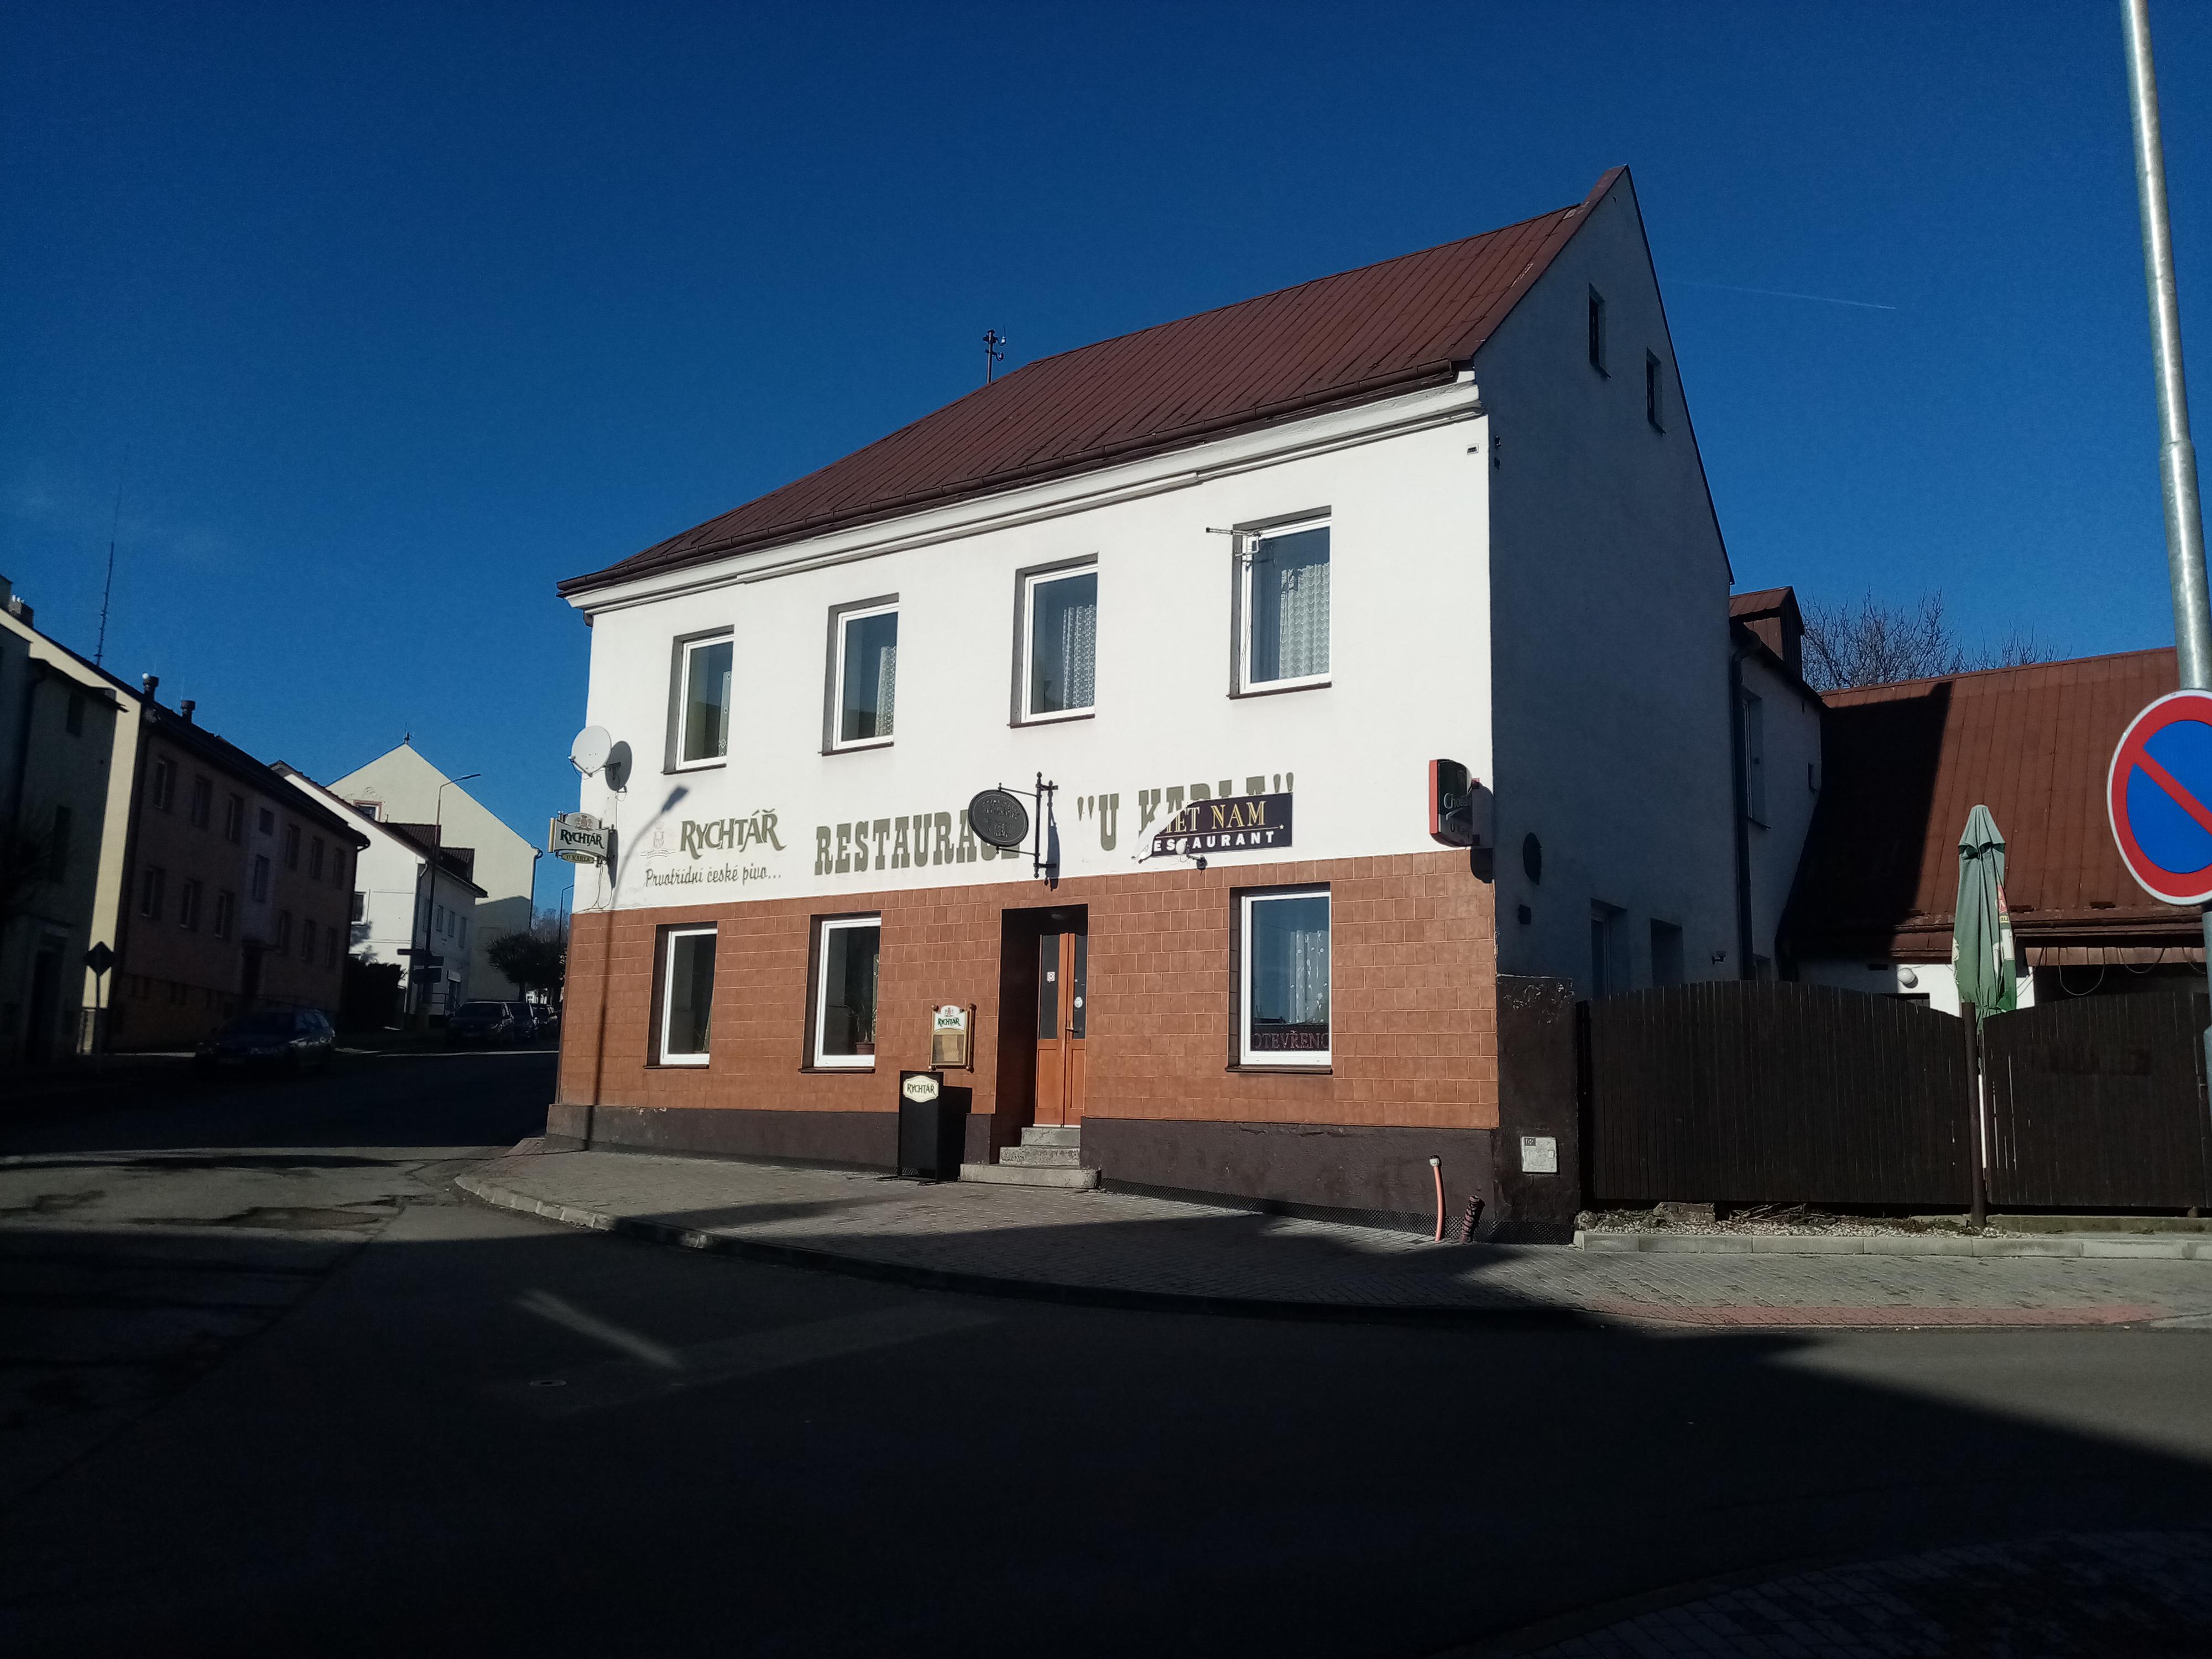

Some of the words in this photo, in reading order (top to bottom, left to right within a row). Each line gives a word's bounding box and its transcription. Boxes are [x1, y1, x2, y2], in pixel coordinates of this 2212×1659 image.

[1211, 801, 1267, 830] NAM
[560, 829, 605, 849] RYCHTÁŘ
[680, 808, 787, 860] RYCHTÁŘ
[645, 865, 704, 888] Prvotřídní
[707, 862, 739, 883] české
[906, 1083, 937, 1096] RYCHTÁŘ
